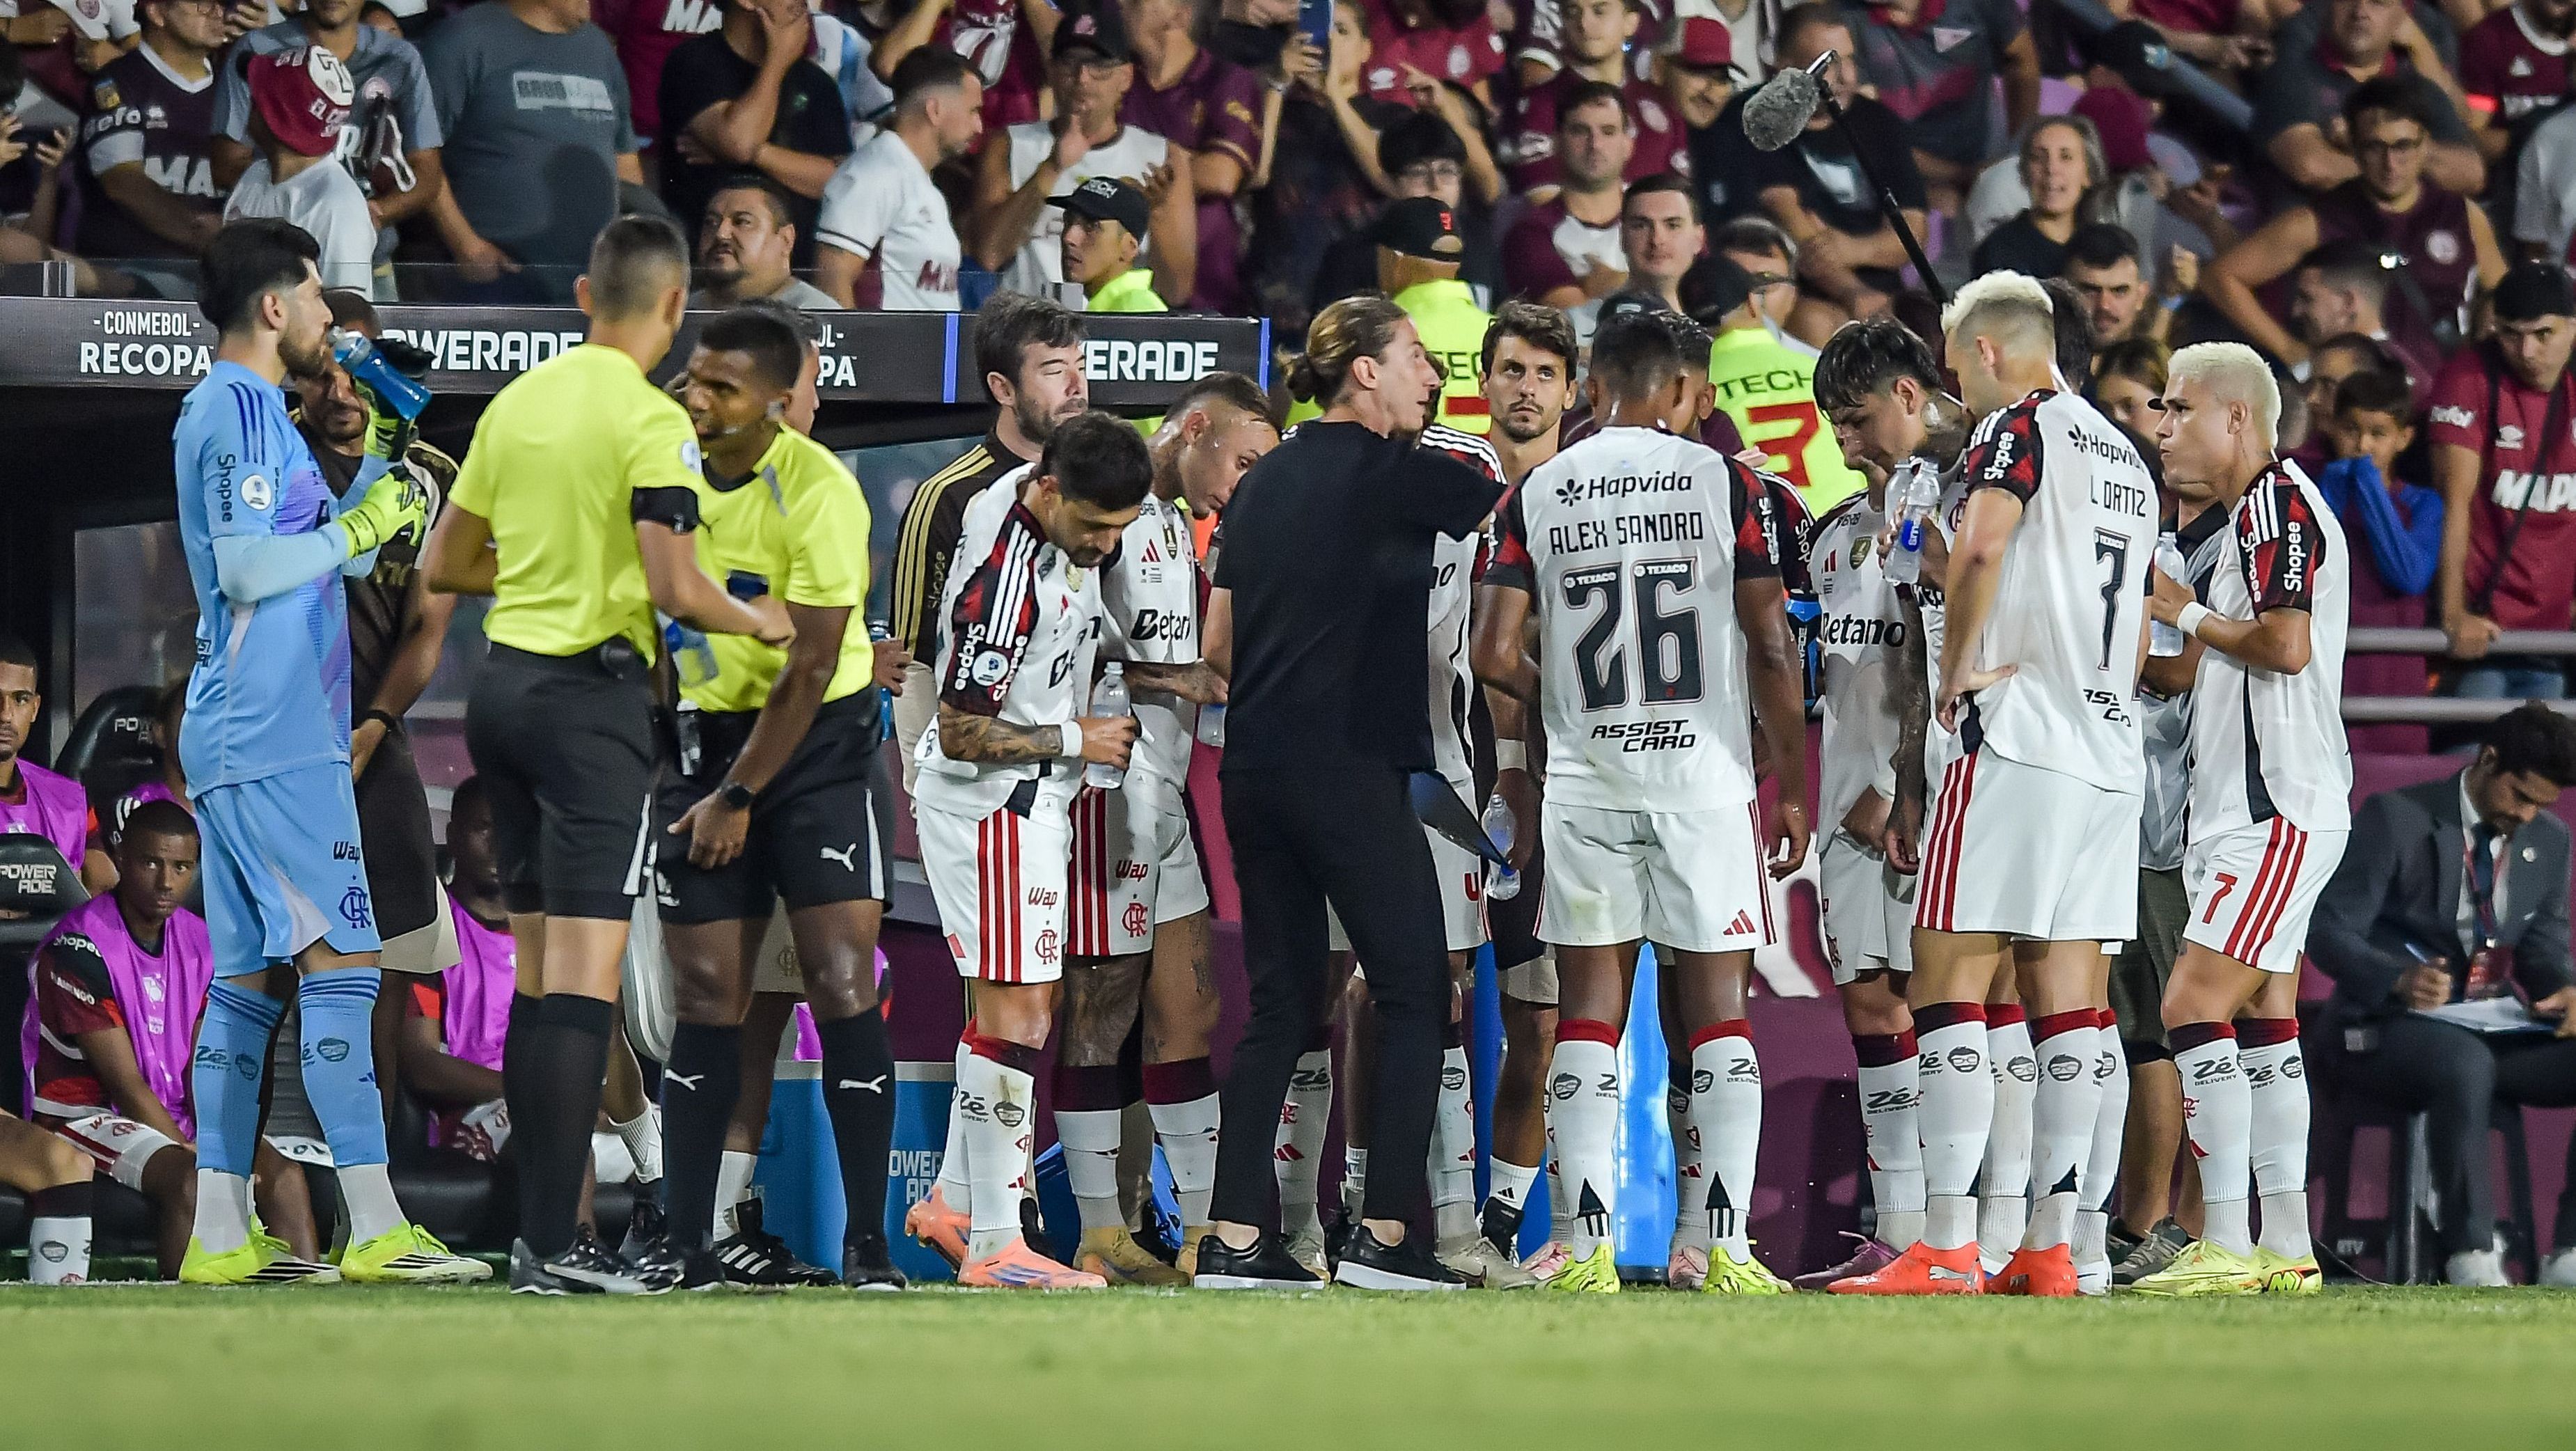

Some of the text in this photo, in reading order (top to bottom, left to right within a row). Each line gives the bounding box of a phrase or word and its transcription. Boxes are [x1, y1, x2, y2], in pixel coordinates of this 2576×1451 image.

[80, 343, 210, 376] RECOPA
[1081, 340, 1219, 381] ERADE
[1984, 431, 2015, 480] Shopee
[217, 453, 236, 523] Shopee
[1587, 471, 1693, 499] Hapvida
[2090, 474, 2146, 518] L ORTIZ
[1549, 511, 1704, 556] ALEX SANDRO
[1645, 561, 1689, 577] TEXACO
[2284, 521, 2302, 592] Shopee
[1576, 570, 1617, 587] TEXACO
[1561, 556, 1706, 714] 26
[955, 622, 987, 691] Shopee
[1591, 719, 1689, 739] ASSIST
[1621, 732, 1696, 753] CARD
[0, 864, 56, 880] POWER
[1115, 860, 1149, 882] Wap
[18, 879, 53, 895] ADE
[1028, 886, 1058, 911] Wap
[2201, 872, 2238, 925] 7
[2193, 1056, 2236, 1080] Zé
[2194, 1074, 2238, 1087] DELIVERY
[1866, 1086, 1919, 1109] Zé
[888, 1150, 942, 1178] OWER
